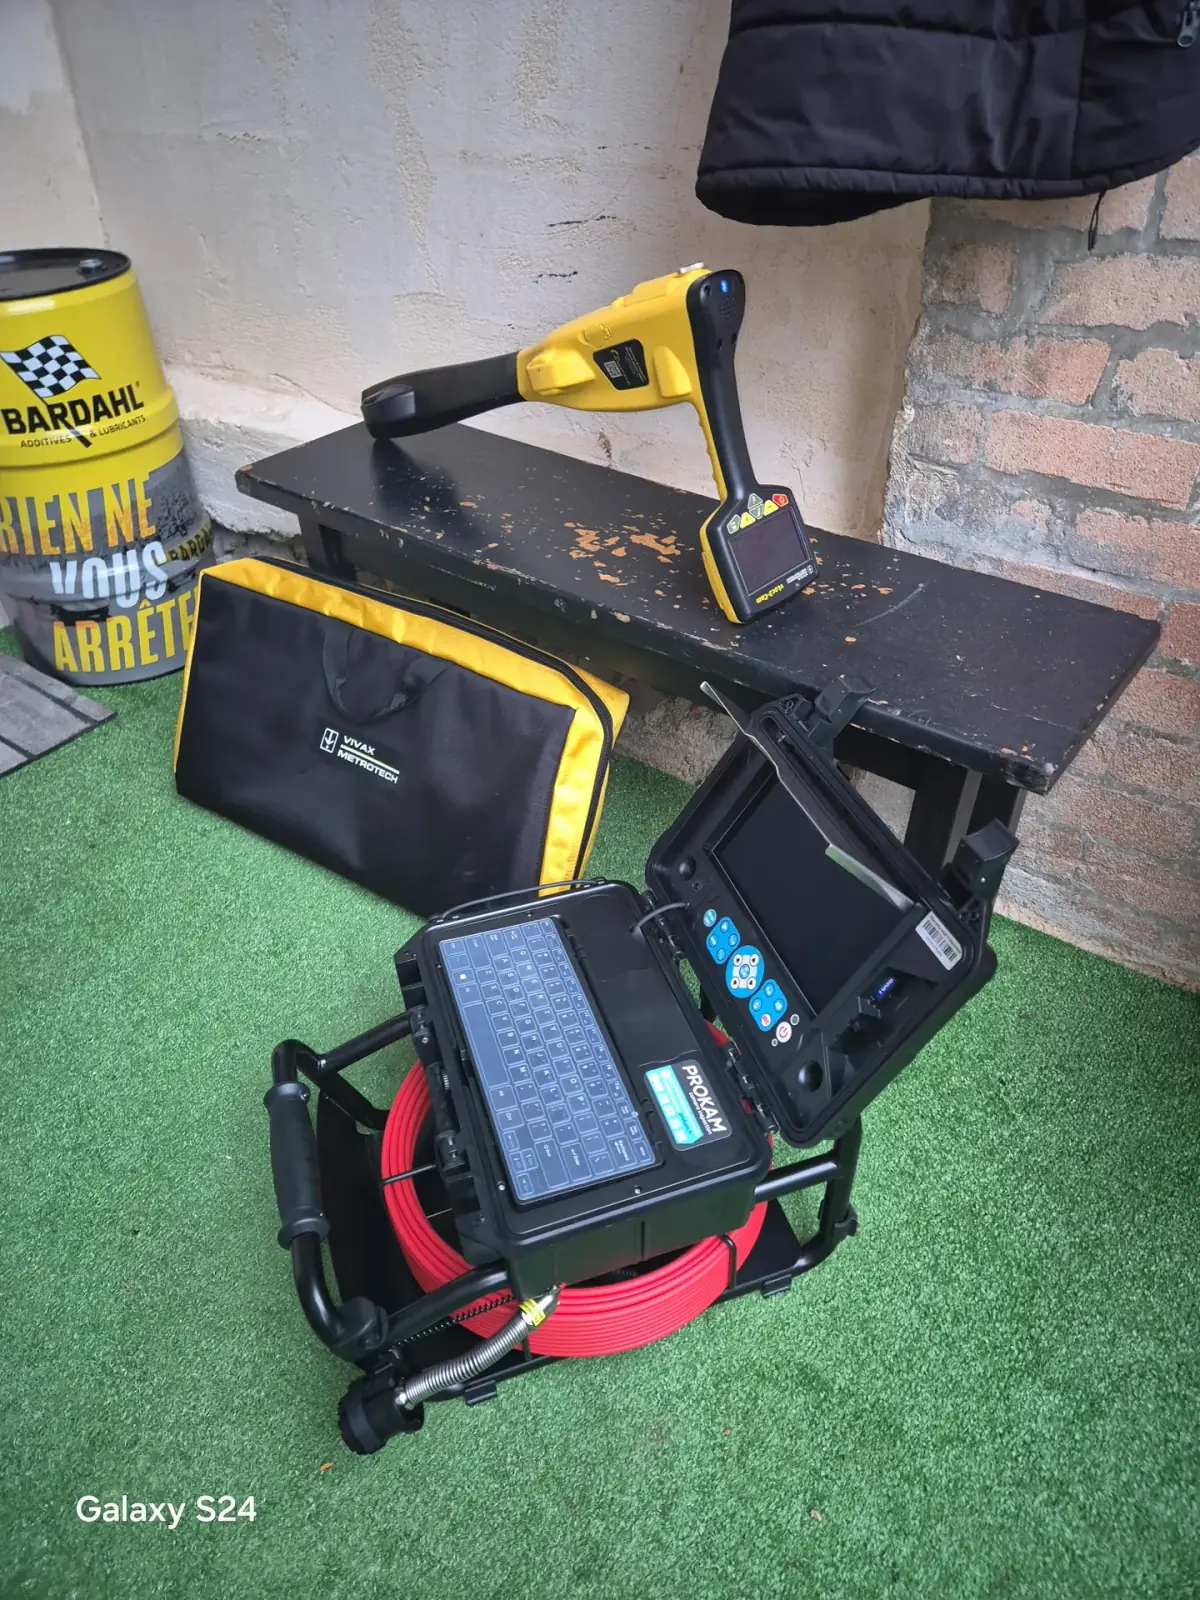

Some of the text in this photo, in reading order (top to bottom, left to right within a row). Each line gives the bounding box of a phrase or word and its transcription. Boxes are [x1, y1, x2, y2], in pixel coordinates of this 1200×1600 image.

[0, 384, 144, 434] BARDAHL
[21, 415, 146, 448] ADDITIVES & LUBRICANTS
[0, 474, 156, 555] RIEN NE
[50, 541, 168, 608] VOUS
[53, 584, 199, 673] ARRÊTE
[337, 749, 398, 784] METROTECH
[344, 735, 376, 755] VIVAX
[681, 1065, 727, 1132] PROKAM
